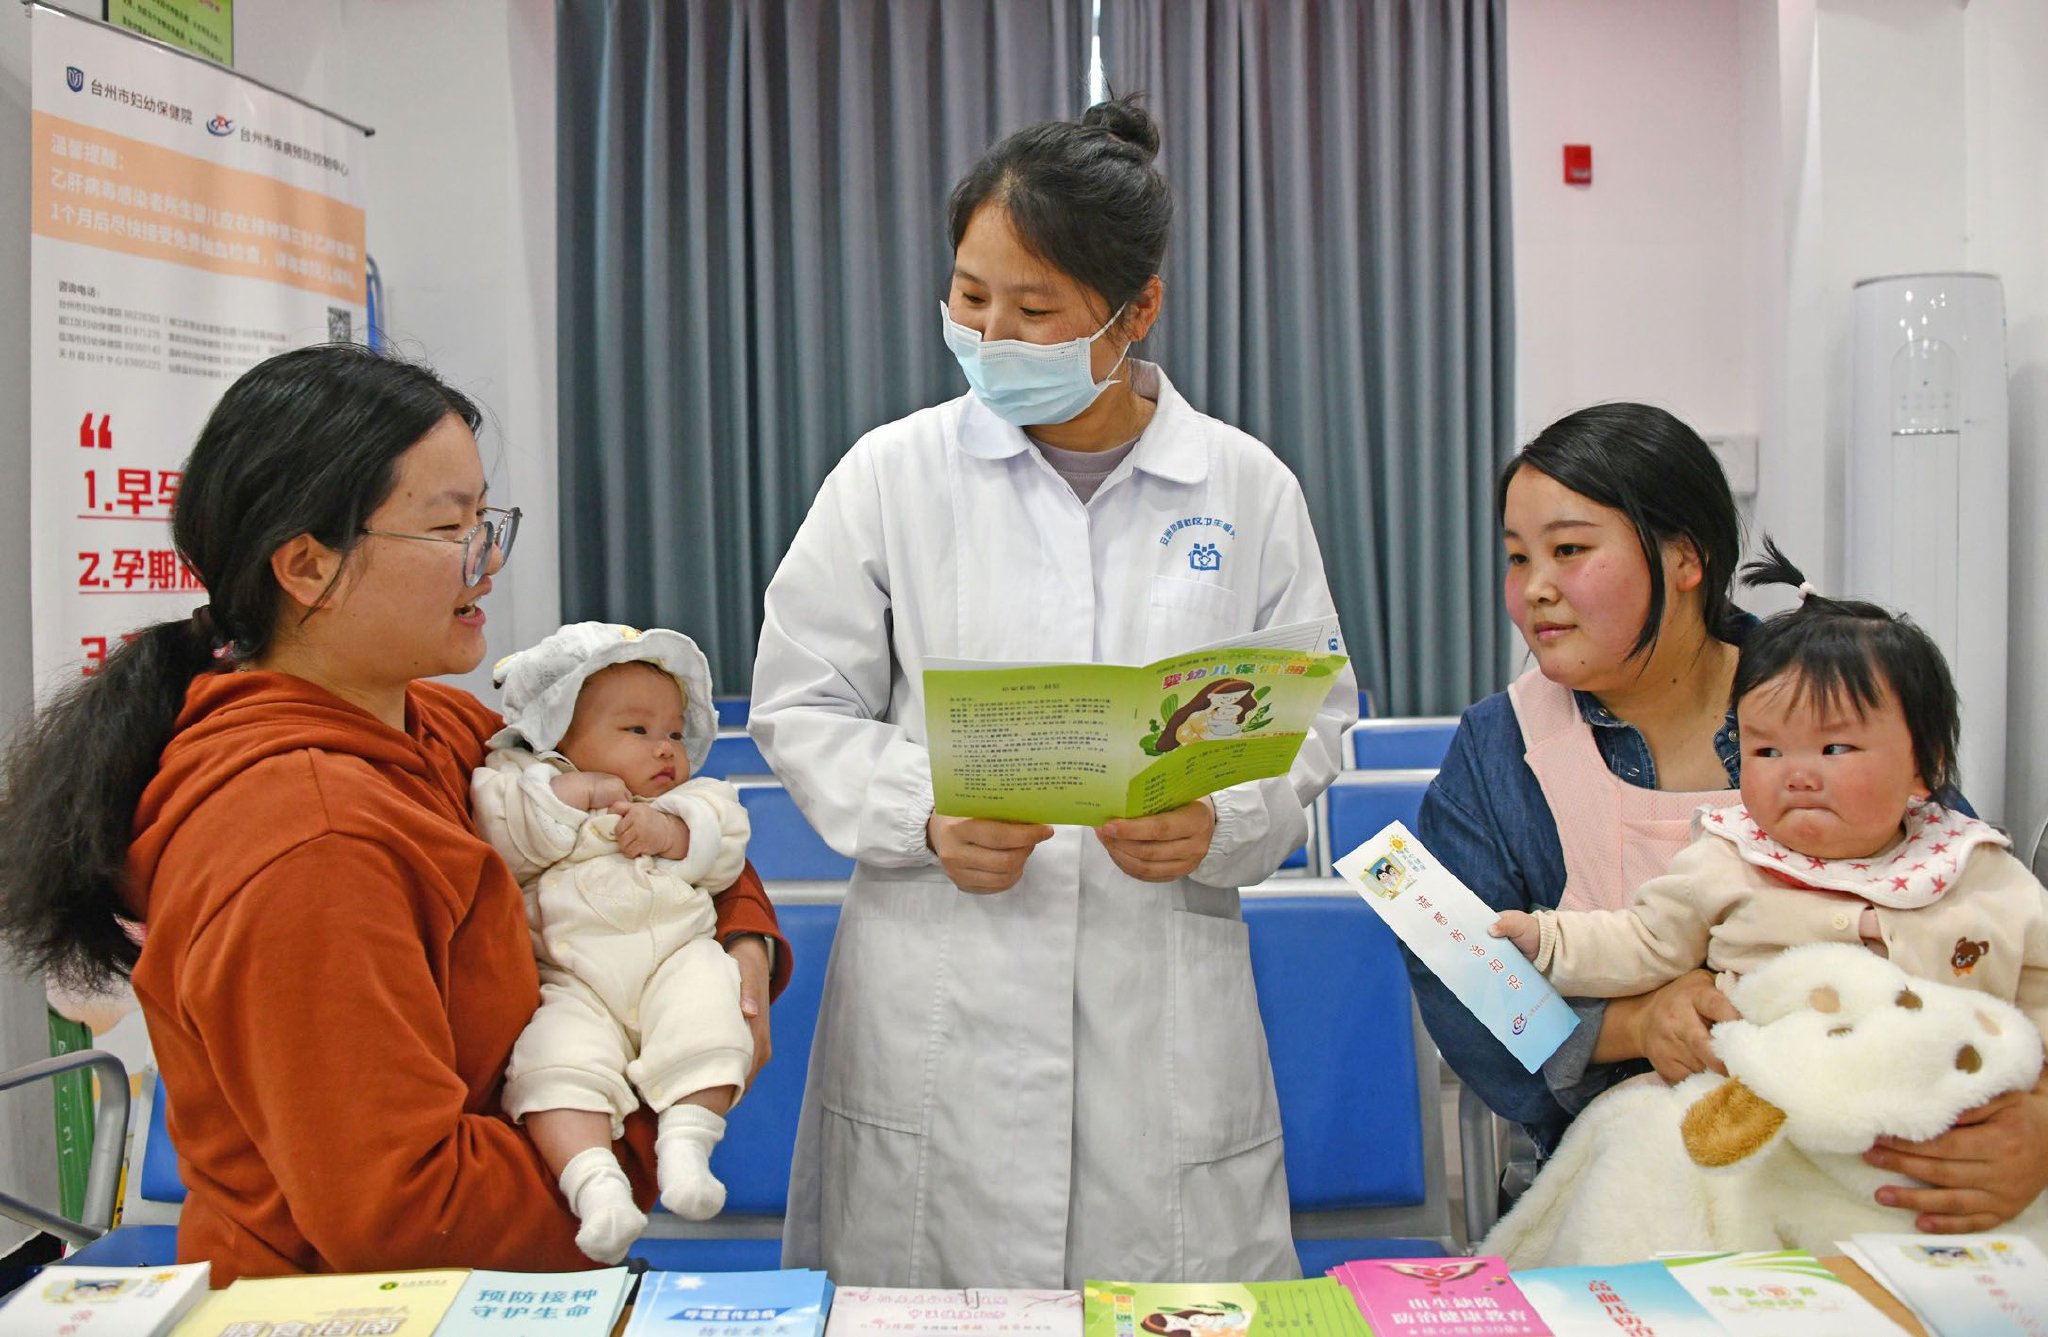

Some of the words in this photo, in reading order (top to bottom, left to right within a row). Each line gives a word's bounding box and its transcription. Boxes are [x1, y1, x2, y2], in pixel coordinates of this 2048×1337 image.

[91, 79, 193, 125] 台州市妇幼保健院
[240, 127, 349, 177] 台州市疾病预防控制中心
[1416, 895, 1523, 990] 流感防治知识
[471, 1305, 591, 1319] 守护生命
[478, 1290, 597, 1304] 预防接种
